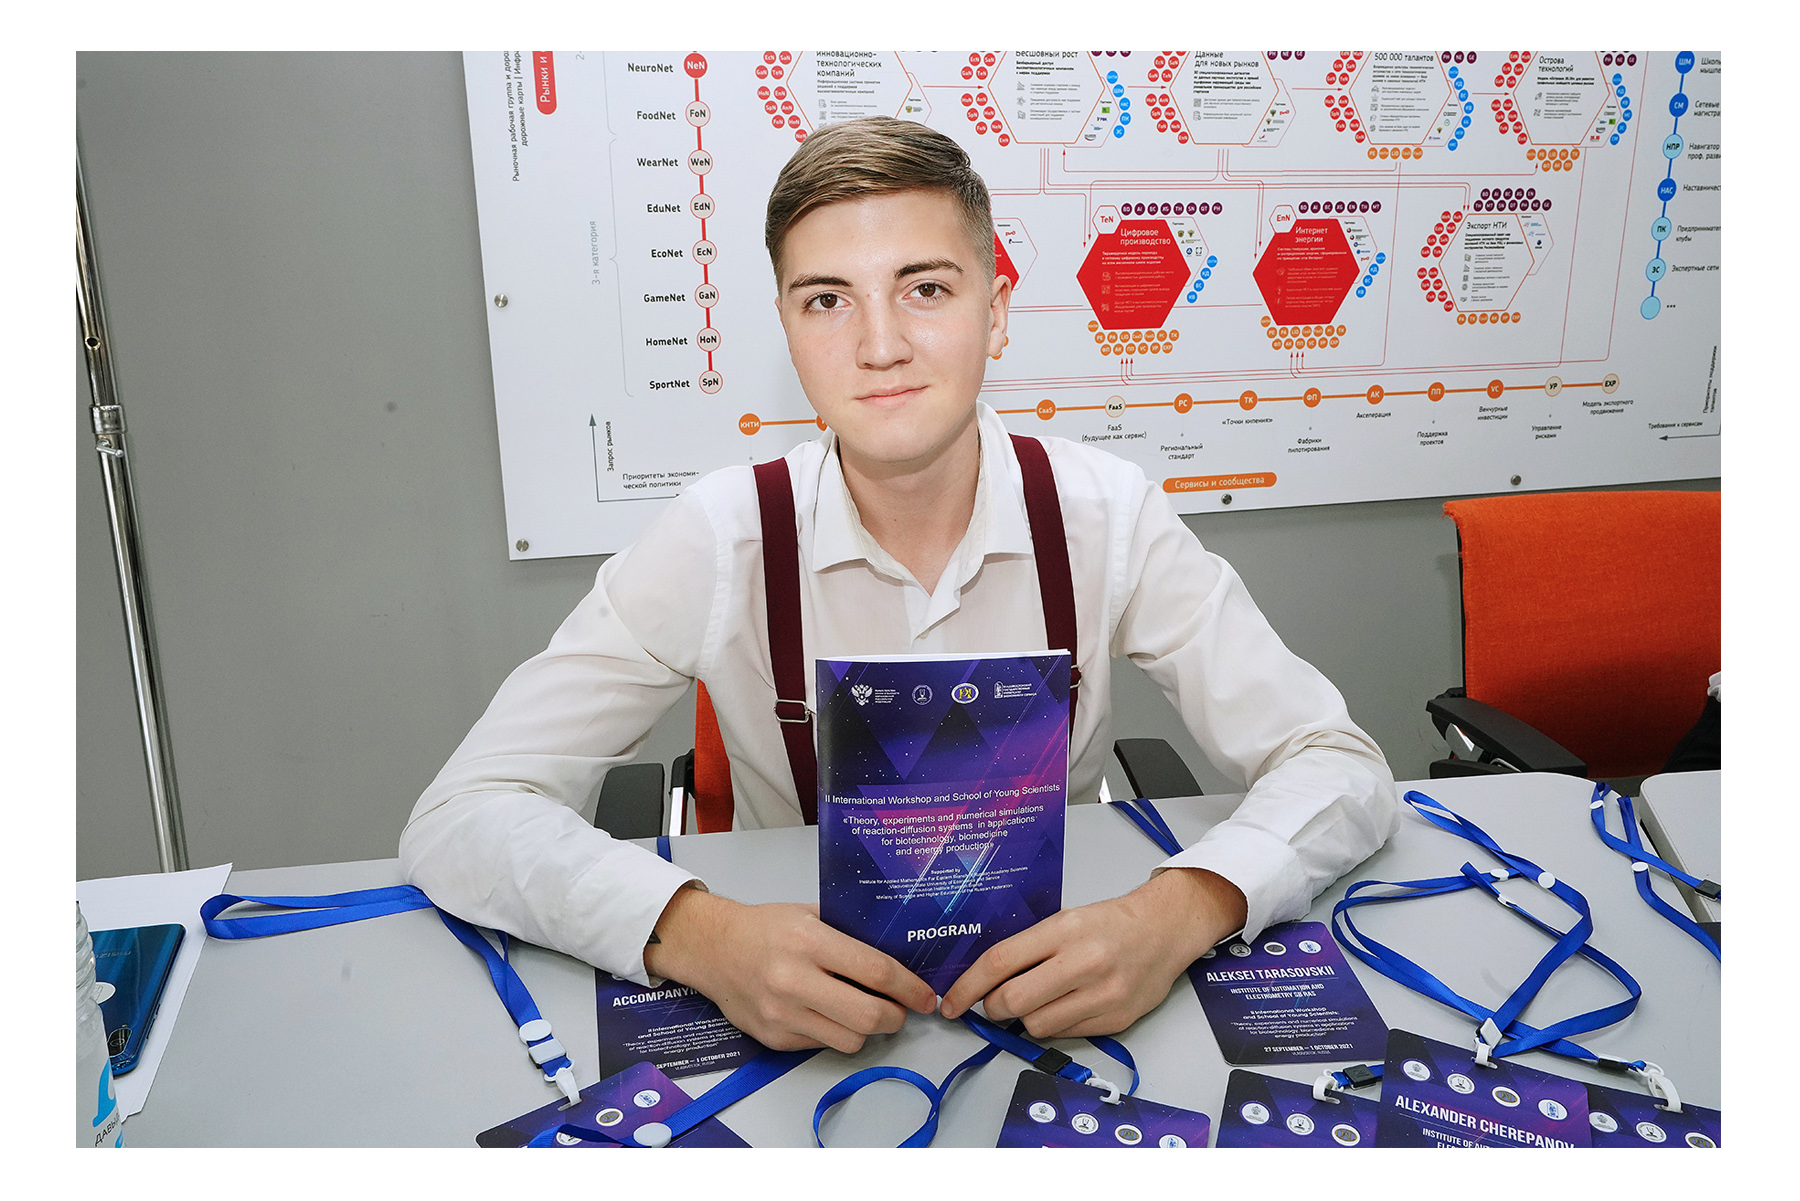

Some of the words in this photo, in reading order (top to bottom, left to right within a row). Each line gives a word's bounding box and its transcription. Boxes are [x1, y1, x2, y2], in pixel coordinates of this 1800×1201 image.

[540, 56, 547, 64] и
[816, 51, 877, 59] инновационно-
[1062, 51, 1078, 59] рост
[1195, 51, 1223, 59] Данные
[1374, 52, 1388, 61] 500
[1389, 52, 1403, 61] 000
[686, 60, 706, 71] NeN
[816, 60, 882, 69] технологических
[1194, 60, 1208, 68] для
[1539, 56, 1564, 65] Острова
[1679, 58, 1692, 66] ШМ
[627, 62, 674, 74] NeuroNet
[816, 69, 855, 77] компаний
[1538, 64, 1573, 73] технологий
[539, 67, 551, 103] Рынки
[505, 82, 515, 109] группа
[516, 81, 524, 105] карты
[1694, 100, 1720, 108] Сетевые
[636, 111, 676, 121] FoodNet
[689, 108, 707, 119] FoN
[507, 111, 518, 142] рабочая
[518, 107, 529, 147] дорожные
[1688, 142, 1720, 151] Навигатор
[1687, 152, 1704, 160] проф.
[510, 145, 520, 182] Рыночная
[636, 157, 679, 167] WearNet
[690, 157, 711, 167] WeN
[646, 203, 681, 213] EduNet
[693, 201, 711, 211] EdN
[1100, 215, 1114, 224] TeN
[1466, 222, 1492, 230] Экспорт
[1493, 221, 1508, 229] НТИ
[1121, 228, 1159, 238] Цифровое
[1295, 227, 1328, 235] Интернет
[589, 221, 600, 267] категория
[1121, 237, 1171, 246] производство
[1295, 236, 1324, 244] энергии
[1675, 235, 1692, 243] клубы
[650, 248, 684, 259] EcoNet
[696, 247, 713, 257] EcN
[1671, 264, 1705, 273] Экспертные
[591, 269, 601, 285] 3-я
[643, 292, 686, 303] GameNet
[698, 291, 716, 300] GaN
[645, 336, 688, 347] HomeNet
[699, 335, 717, 345] HoN
[649, 378, 690, 390] SportNet
[702, 377, 720, 388] SpN
[1431, 388, 1441, 396] ПП
[1703, 379, 1713, 414] Приоритеты
[1306, 393, 1318, 402] ФП
[1108, 403, 1122, 411] FaaS
[1582, 400, 1601, 409] Модель
[1602, 399, 1634, 408] экспортного
[1038, 406, 1053, 415] CaaS
[1479, 405, 1508, 414] Венчурные
[1590, 407, 1624, 415] продвижения
[1245, 417, 1274, 425] кипения»
[1356, 412, 1391, 420] Акселерация
[1477, 413, 1508, 421] инвестиции
[605, 420, 614, 445] рынков
[1531, 424, 1562, 433] Управление
[1081, 433, 1111, 442] (будущее
[1124, 431, 1147, 440] сервис)
[1417, 430, 1448, 439] Поддержка
[1535, 432, 1557, 440] рисками
[1297, 437, 1322, 446] Фабрики
[1419, 438, 1444, 446] проектов
[1160, 443, 1204, 452] Региональный
[1287, 445, 1331, 454] пилотирования
[606, 446, 615, 472] Запрос
[1168, 453, 1195, 461] стандарт
[622, 472, 666, 482] Приоритеты
[666, 470, 700, 480] экономи-
[623, 481, 648, 490] ческой
[649, 480, 682, 489] политики
[1174, 480, 1209, 490] Сервисы
[1218, 477, 1265, 486] сообщества
[832, 795, 886, 805] International
[888, 795, 931, 805] Workshop
[933, 793, 950, 802] and
[952, 791, 982, 801] School
[983, 790, 993, 799] of
[993, 788, 1020, 799] Young
[1021, 784, 1060, 795] Scientists
[843, 816, 880, 827] «Theory,
[882, 814, 936, 826] experiments
[937, 813, 954, 822] and
[956, 809, 997, 821] numerical
[998, 804, 1044, 817] simulations
[851, 826, 861, 835] of
[862, 824, 936, 835] reaction-diffusion
[938, 821, 974, 832] systems
[977, 820, 985, 829] in
[987, 816, 1036, 828] applications
[881, 837, 893, 846] for
[895, 833, 957, 846] biotechnology,
[958, 829, 1009, 841] biomedicine
[895, 847, 912, 855] and
[914, 845, 943, 856] energy
[945, 841, 995, 853] production»
[906, 922, 982, 943] PROGRAM
[1206, 969, 1256, 982] ALEKSEI
[1256, 965, 1335, 980] TARASOVSKII
[1230, 986, 1263, 994] INSTITUTE
[1271, 984, 1311, 993] AUTOMATION
[1245, 992, 1294, 1000] ELECTROMETRY
[656, 1059, 690, 1070] SEPTEMBER
[700, 1053, 726, 1062] OCTOBER
[1395, 1094, 1477, 1130] ALEXANDER
[1422, 1127, 1462, 1146] INSTITUTE
[1462, 1138, 1473, 1148] OF
